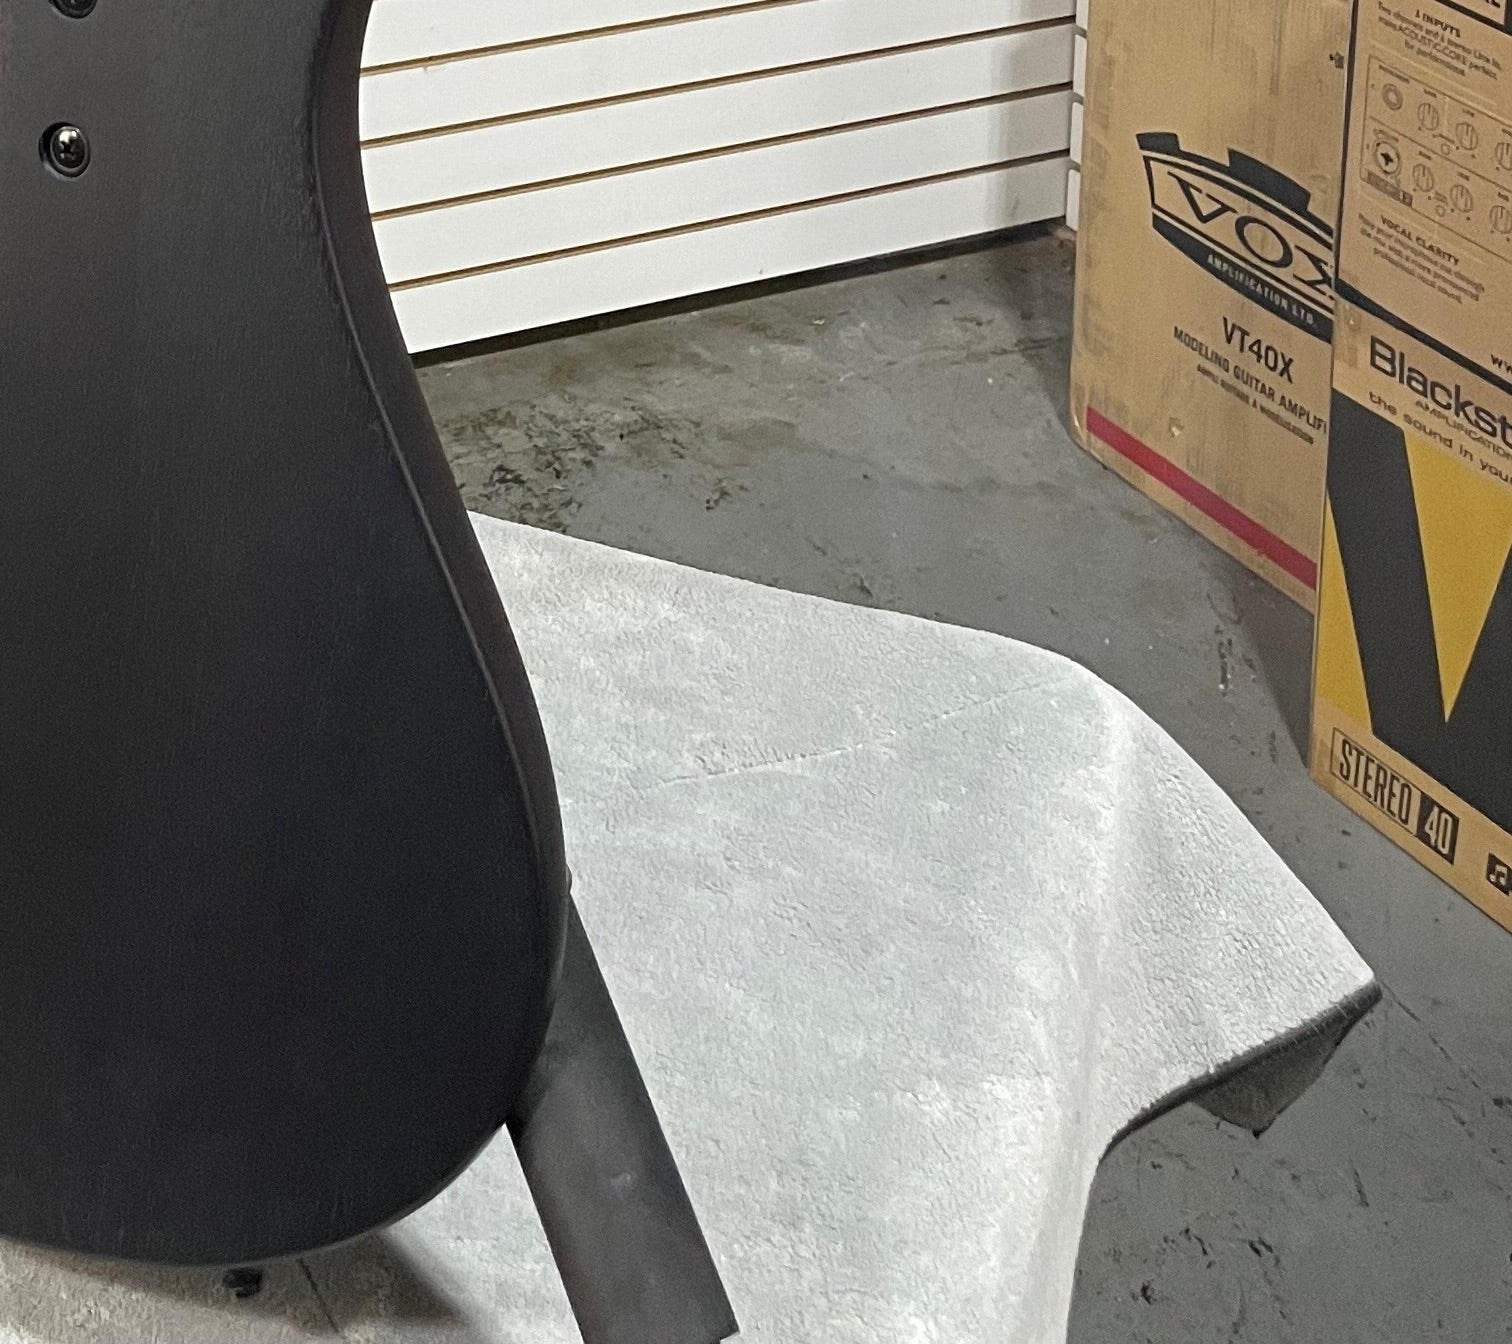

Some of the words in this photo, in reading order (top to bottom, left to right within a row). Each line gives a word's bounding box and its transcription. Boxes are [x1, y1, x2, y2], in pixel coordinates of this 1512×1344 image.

[1166, 170, 1334, 301] VOX
[1380, 214, 1413, 242] VOCAL
[1415, 235, 1460, 266] CLARITY
[1206, 253, 1289, 312] AMPLIFICATION
[1173, 325, 1230, 374] MODELING
[1233, 364, 1277, 403] GUITAR
[1222, 315, 1295, 384] VT40X
[1368, 390, 1398, 417] the
[1402, 412, 1454, 450] sound
[1458, 443, 1474, 462] in
[1338, 737, 1413, 827] STEREO
[1424, 804, 1454, 856] 40
